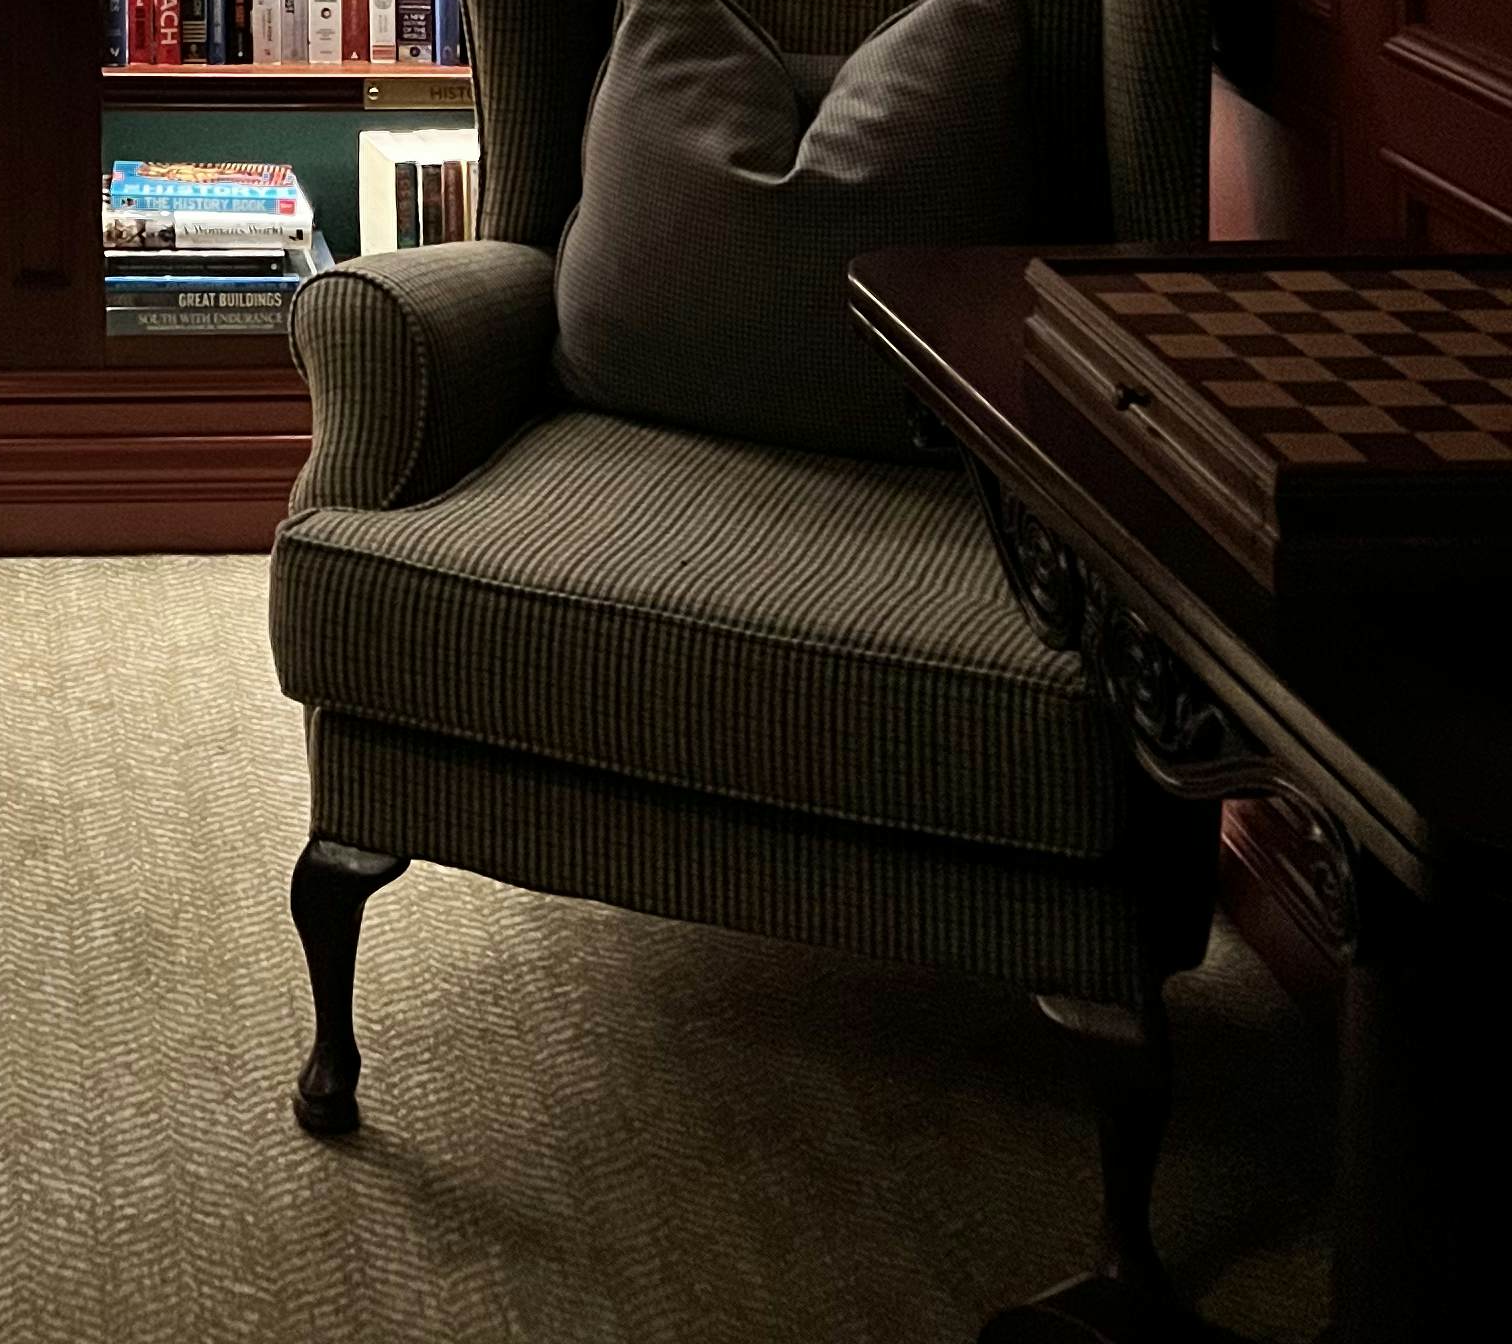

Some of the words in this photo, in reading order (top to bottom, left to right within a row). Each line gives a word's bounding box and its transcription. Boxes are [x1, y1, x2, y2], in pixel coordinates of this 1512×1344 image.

[144, 197, 170, 209] THE
[173, 197, 230, 210] HISTORY
[233, 199, 266, 210] BOOK
[248, 223, 284, 235] World
[179, 293, 217, 307] GREAT
[219, 292, 282, 306] BUILDINGS
[137, 313, 179, 324] SOUTH
[180, 313, 210, 323] WITH
[213, 312, 283, 324] ENDURANCE
